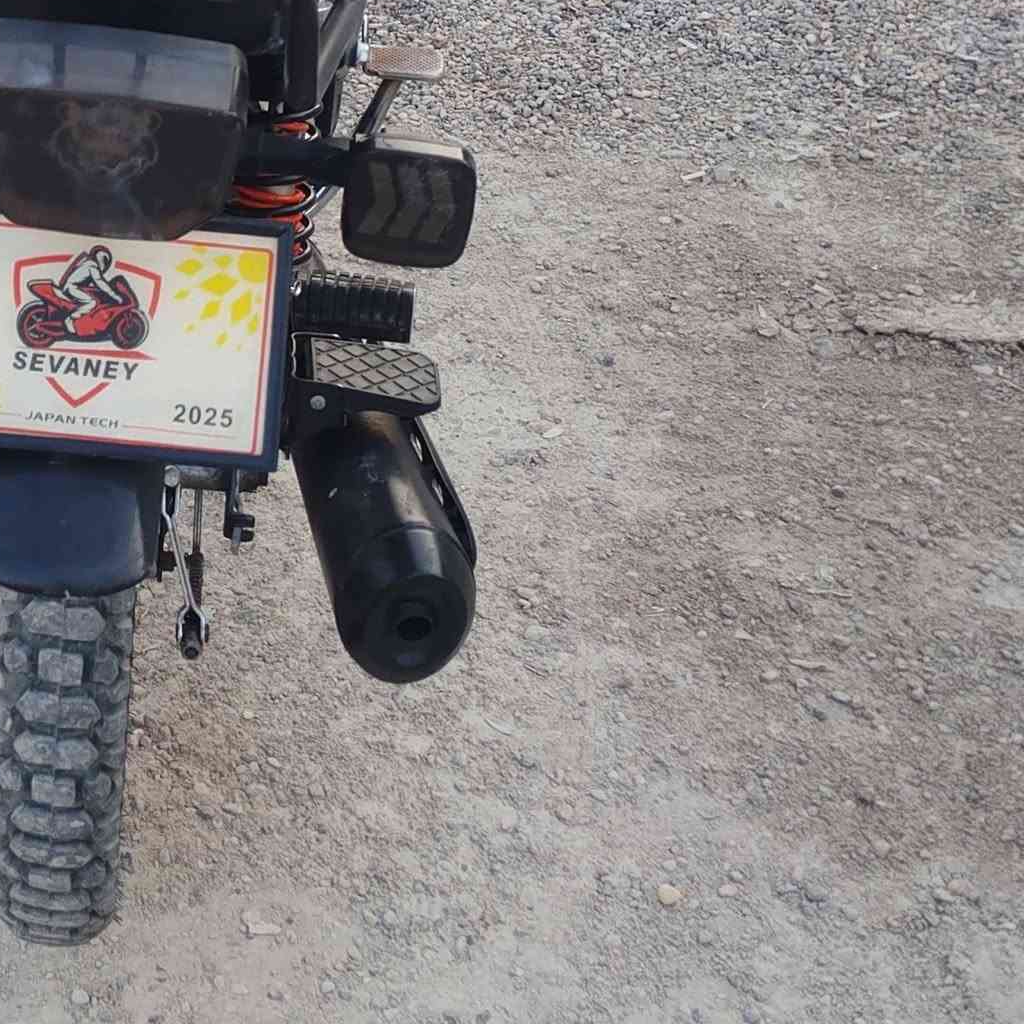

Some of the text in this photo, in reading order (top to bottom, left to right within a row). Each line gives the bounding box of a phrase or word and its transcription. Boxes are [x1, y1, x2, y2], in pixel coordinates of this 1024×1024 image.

[12, 350, 139, 381] SEVANEY
[25, 409, 119, 428] JAPAN TECH
[172, 403, 234, 428] 2025
